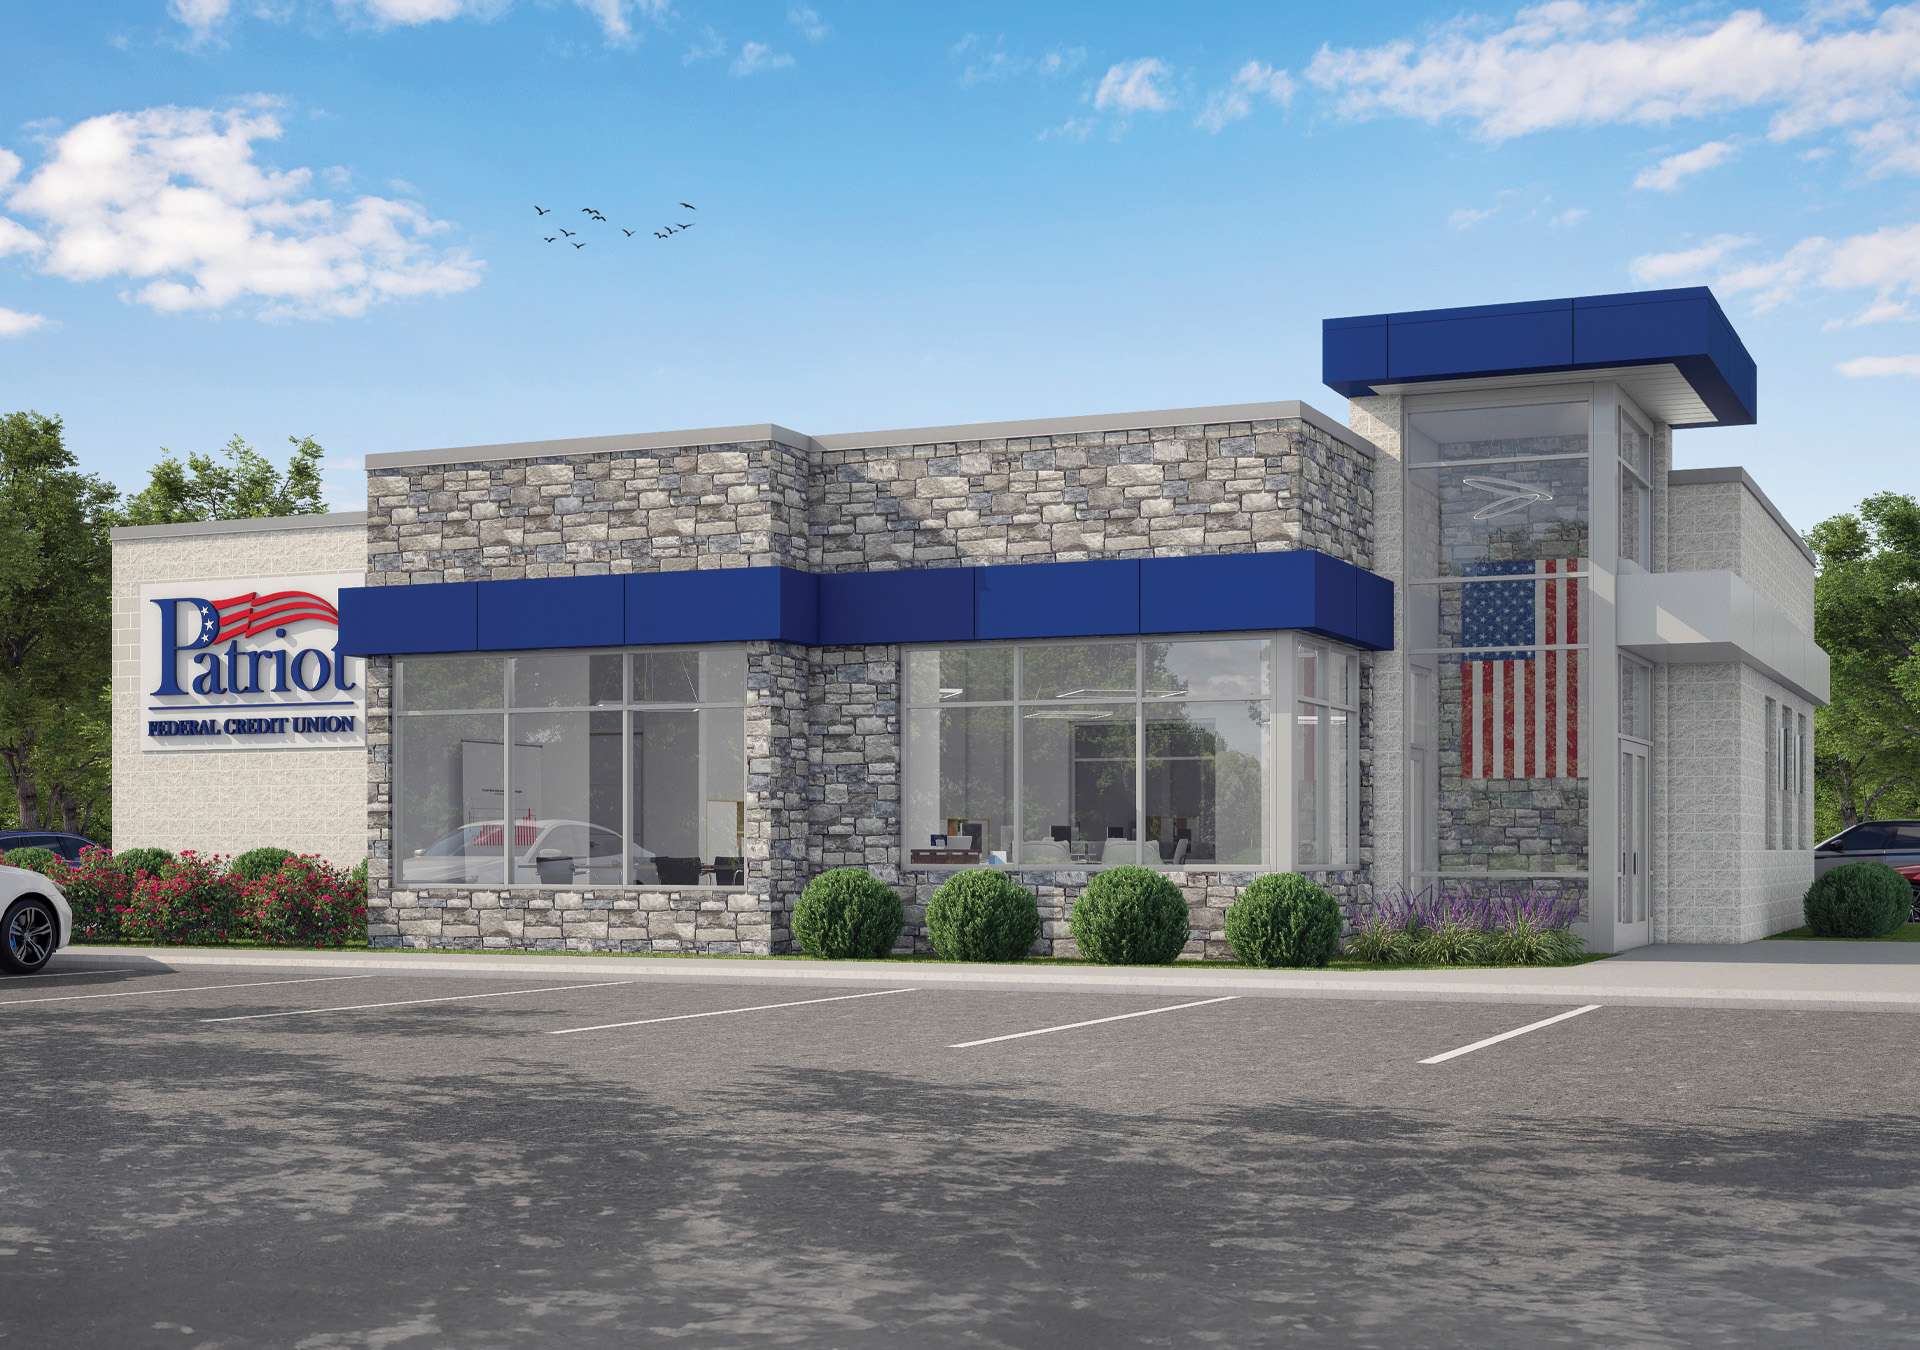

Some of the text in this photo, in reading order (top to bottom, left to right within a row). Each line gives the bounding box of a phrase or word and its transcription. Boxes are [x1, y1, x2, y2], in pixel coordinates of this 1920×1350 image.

[150, 597, 356, 696] Patriot
[147, 715, 356, 737] FEDERAL CREDIT UNION
